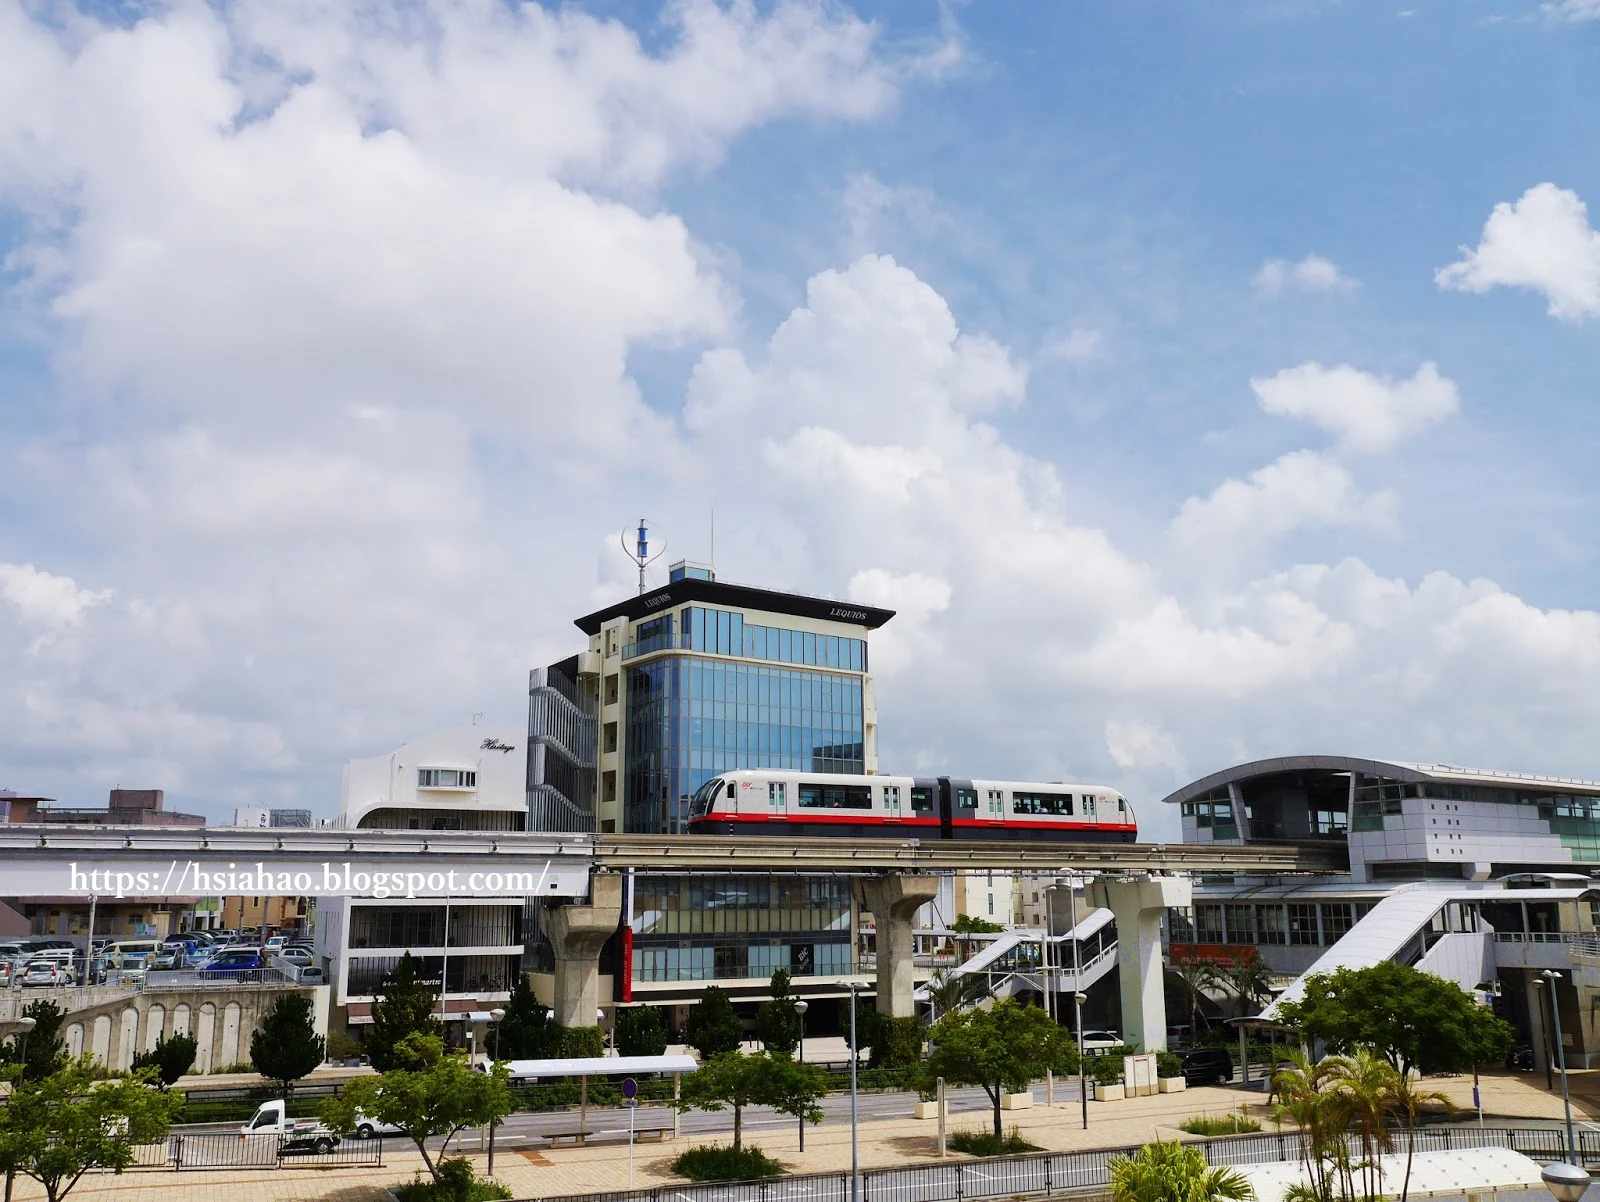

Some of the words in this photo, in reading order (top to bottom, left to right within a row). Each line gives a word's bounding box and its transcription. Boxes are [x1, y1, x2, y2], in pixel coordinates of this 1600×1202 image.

[644, 592, 672, 608] LEQUIOS
[830, 607, 867, 620] LEQUIOS
[480, 737, 515, 754] Heritage
